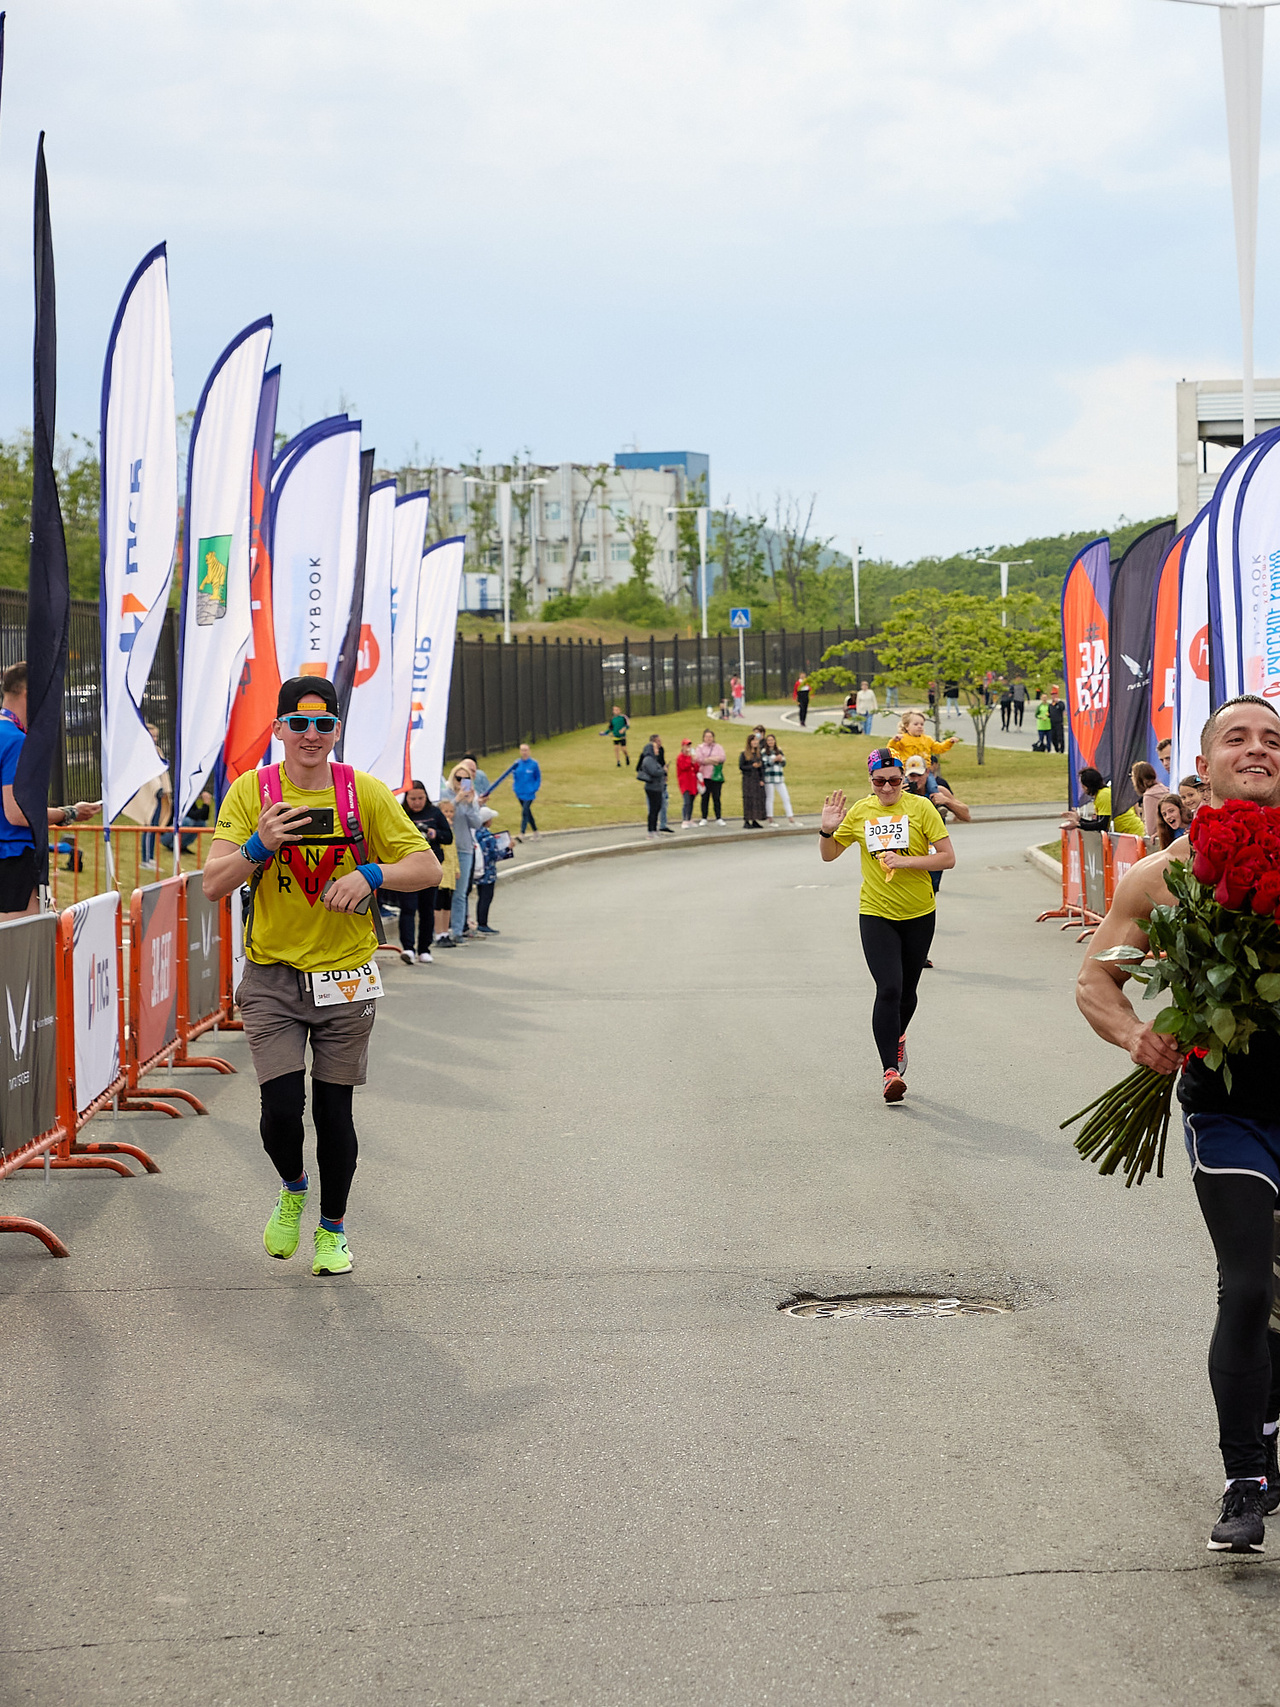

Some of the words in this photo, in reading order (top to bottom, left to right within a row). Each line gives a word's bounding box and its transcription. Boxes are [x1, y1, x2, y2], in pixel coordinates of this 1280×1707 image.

[309, 557, 321, 651] MYBOOK
[869, 823, 903, 837] 30325
[279, 847, 345, 866] ONE
[278, 876, 334, 895] RU
[342, 985, 357, 993] 21,1
